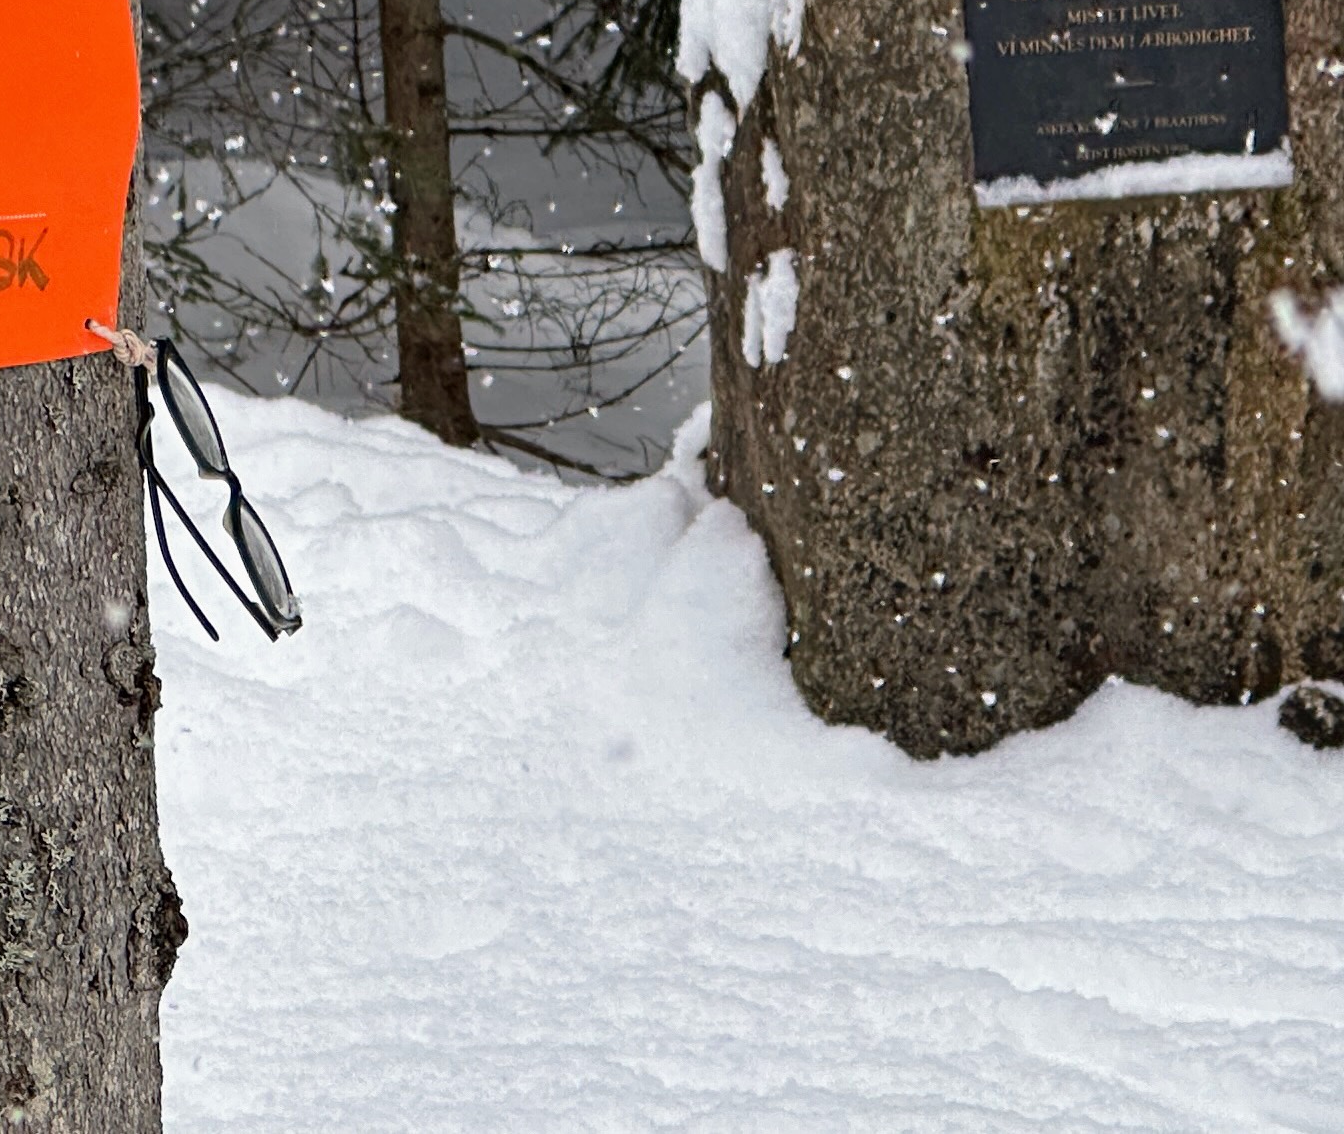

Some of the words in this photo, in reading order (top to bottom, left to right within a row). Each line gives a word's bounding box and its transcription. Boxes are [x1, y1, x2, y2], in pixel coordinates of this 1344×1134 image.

[1067, 6, 1127, 25] MISTET
[997, 39, 1016, 58] VI
[1020, 34, 1085, 55] MINNES
[1089, 34, 1125, 51] DEM
[1129, 33, 1135, 50] I
